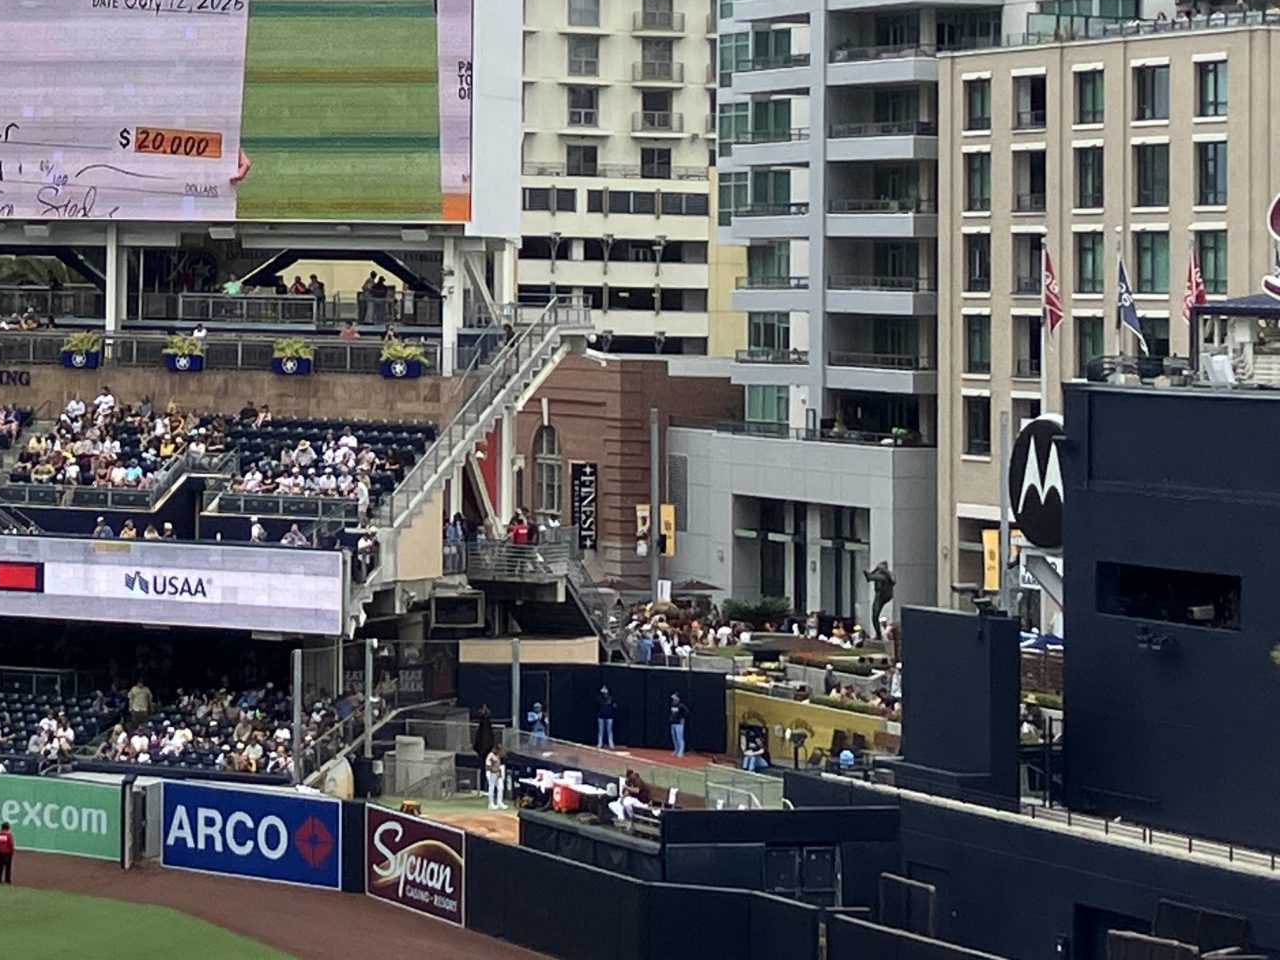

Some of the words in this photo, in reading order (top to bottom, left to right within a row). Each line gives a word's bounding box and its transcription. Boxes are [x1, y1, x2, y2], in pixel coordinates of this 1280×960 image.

[120, 128, 131, 150] $
[153, 575, 207, 598] USAA
[166, 806, 289, 861] ARCO
[373, 821, 453, 897] Sycuan
[434, 894, 457, 911] RESORT
